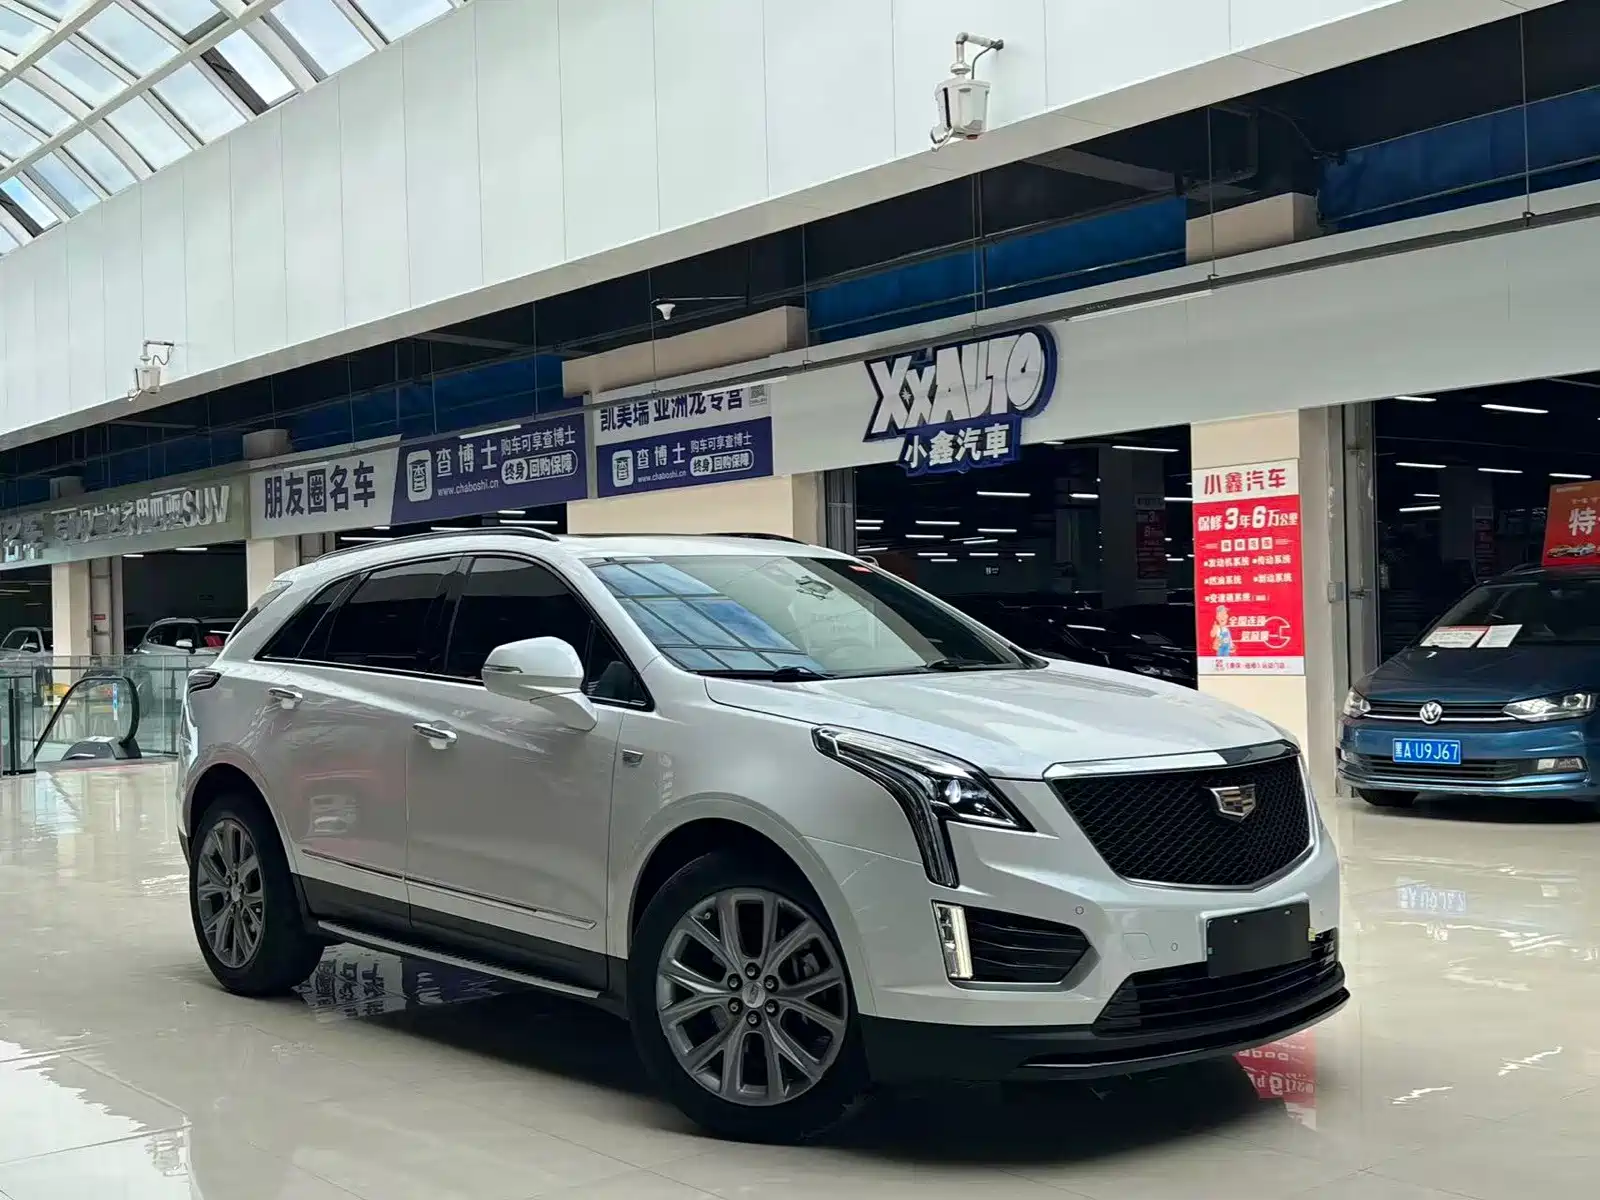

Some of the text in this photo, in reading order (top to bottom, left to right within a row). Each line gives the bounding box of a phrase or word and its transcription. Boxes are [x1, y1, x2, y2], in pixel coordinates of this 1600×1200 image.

[601, 401, 650, 432] 凯美瑞
[501, 425, 576, 457] 购车可享查博士
[690, 431, 752, 454] 购车可享查博士
[904, 423, 1010, 468] 小鑫汽車
[436, 440, 498, 478] 查博士
[504, 453, 573, 481] 终身 回购保障
[637, 442, 686, 470] 查博士
[693, 453, 750, 473] 终身 回购保障
[264, 460, 376, 519] 朋友圈名车
[437, 478, 499, 496] www.chaboshi.cn
[637, 470, 687, 483] www.chaboshi.cn
[1204, 468, 1286, 495] 小鑫汽车
[1568, 507, 1600, 536] 特
